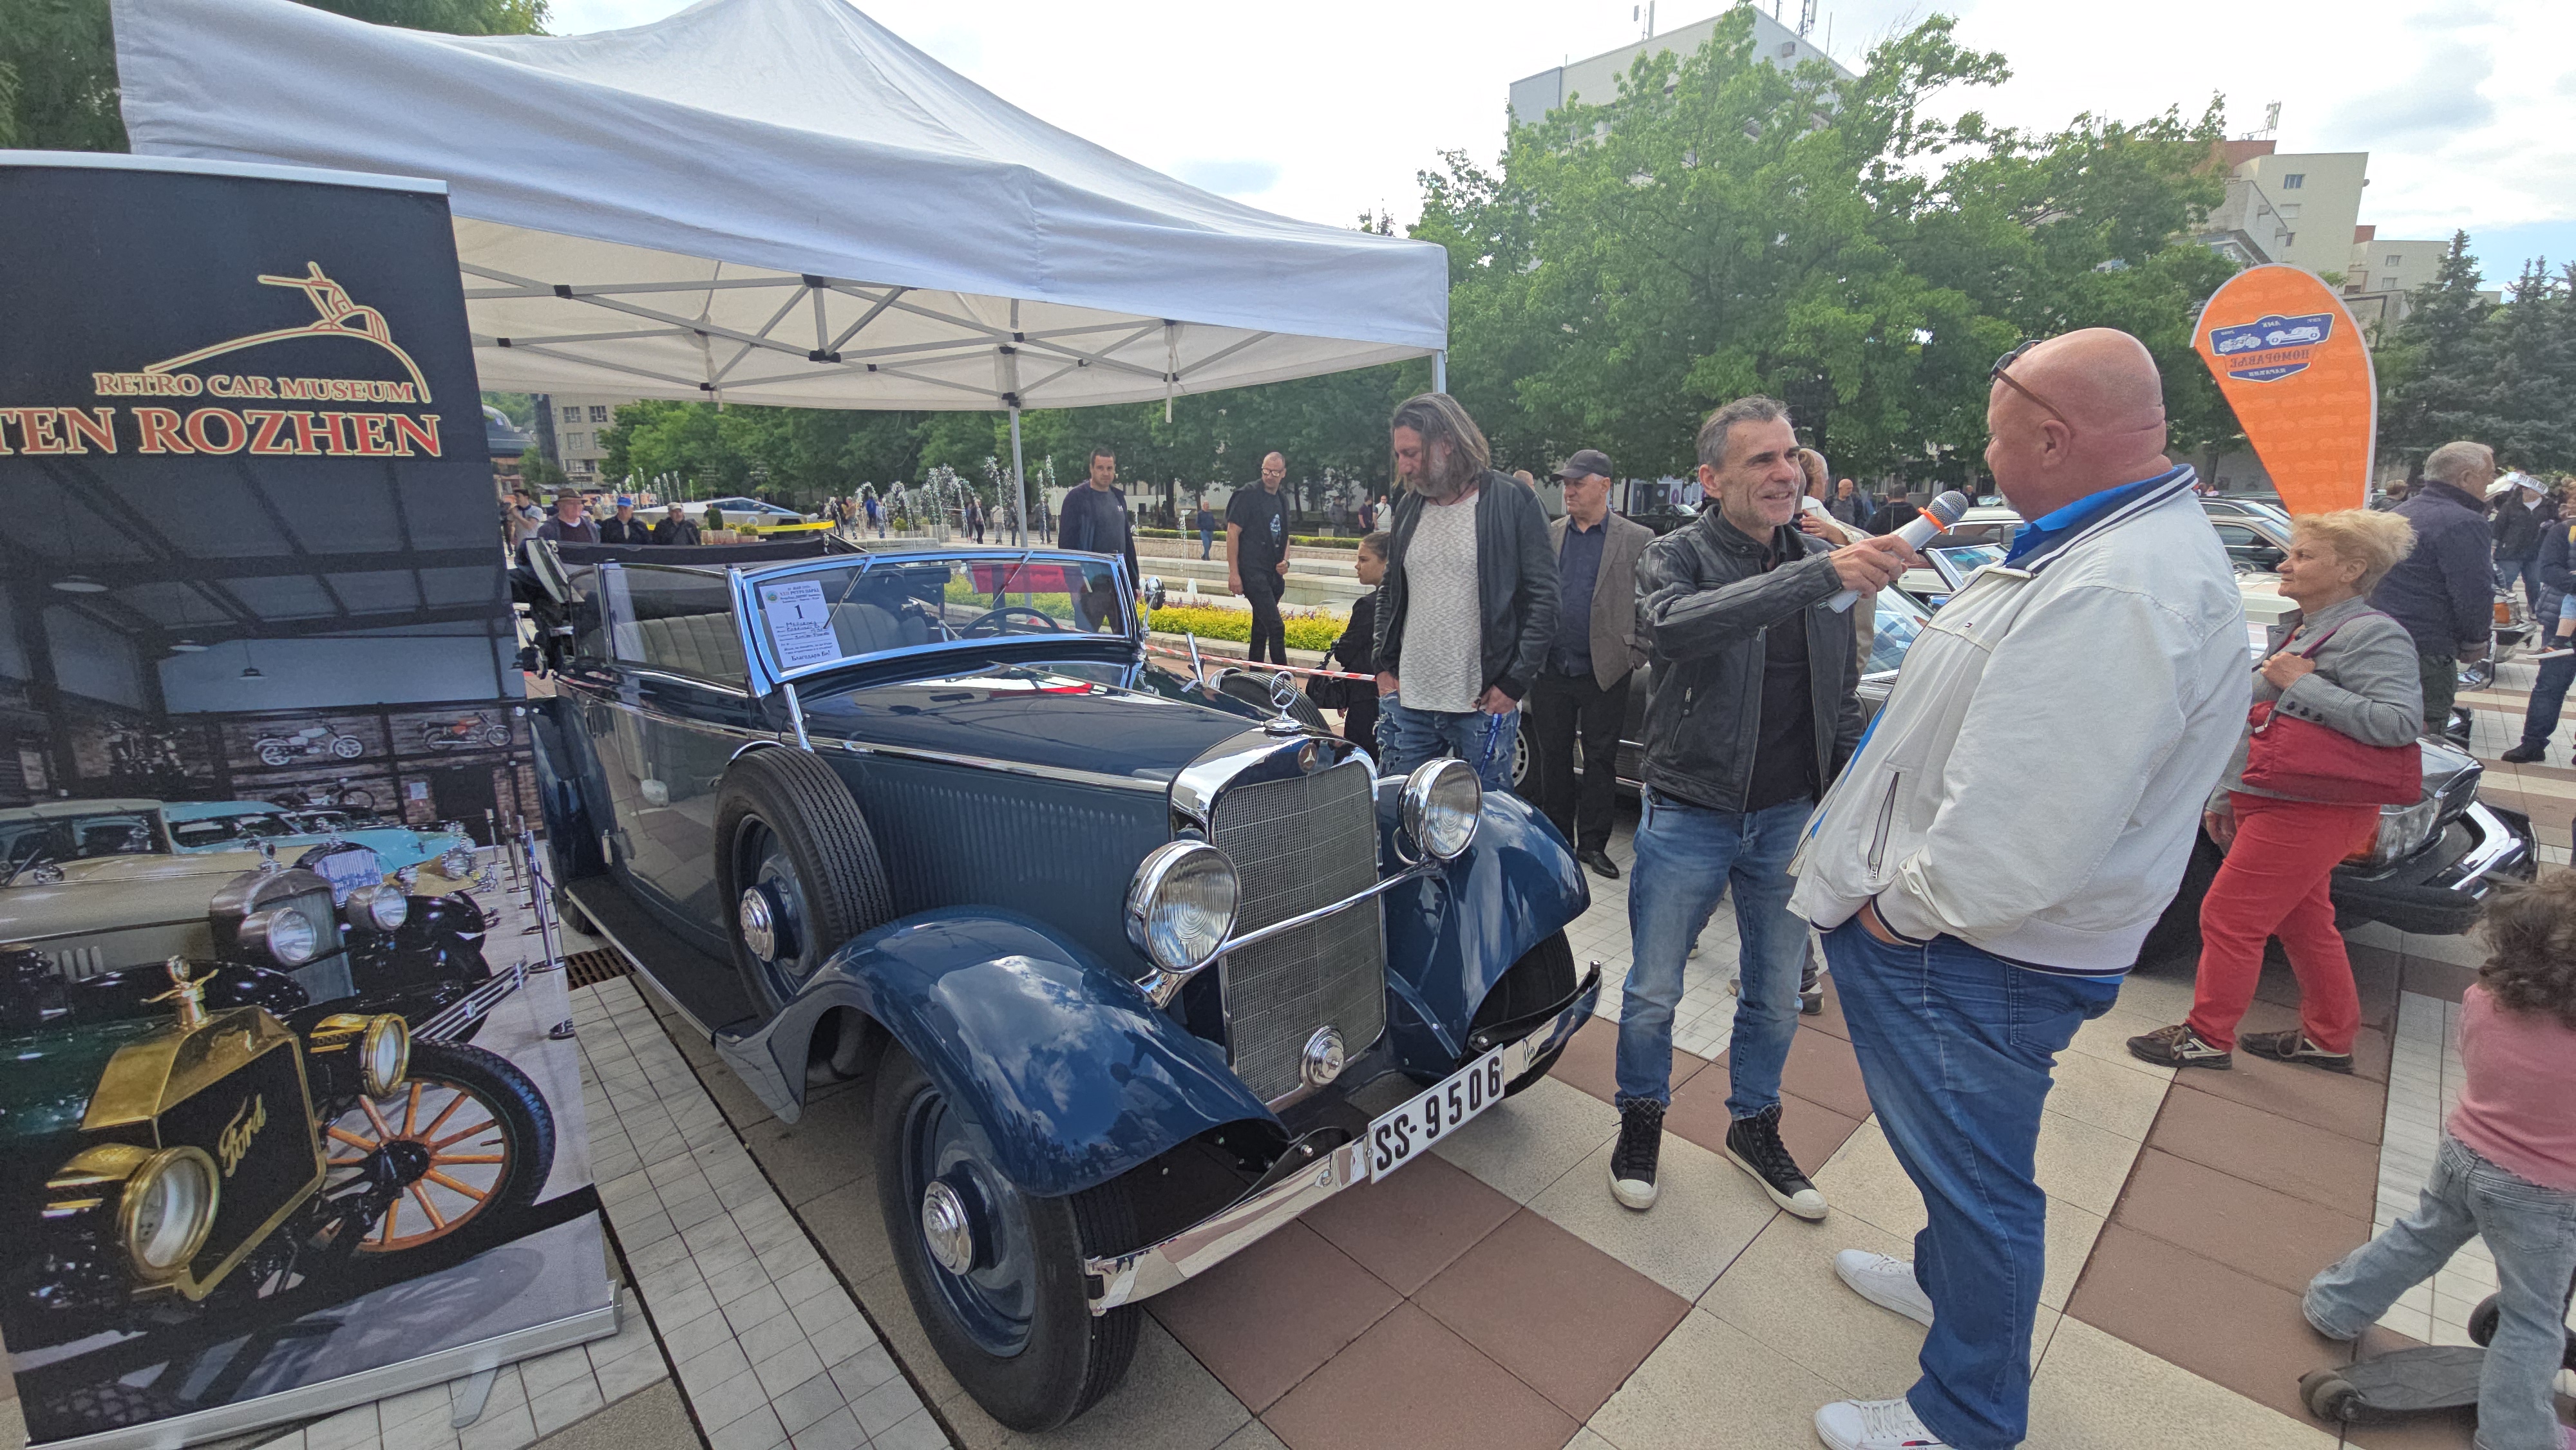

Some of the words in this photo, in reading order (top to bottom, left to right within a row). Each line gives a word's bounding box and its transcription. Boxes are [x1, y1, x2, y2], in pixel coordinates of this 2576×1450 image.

[93, 373, 203, 396] RETRO
[207, 375, 278, 398] CAR
[277, 377, 416, 402] MUSEUM
[131, 408, 442, 457] ROZHEN
[795, 604, 804, 619] 1
[220, 1093, 266, 1178] Ford
[1376, 1056, 1501, 1171] SS-9506
